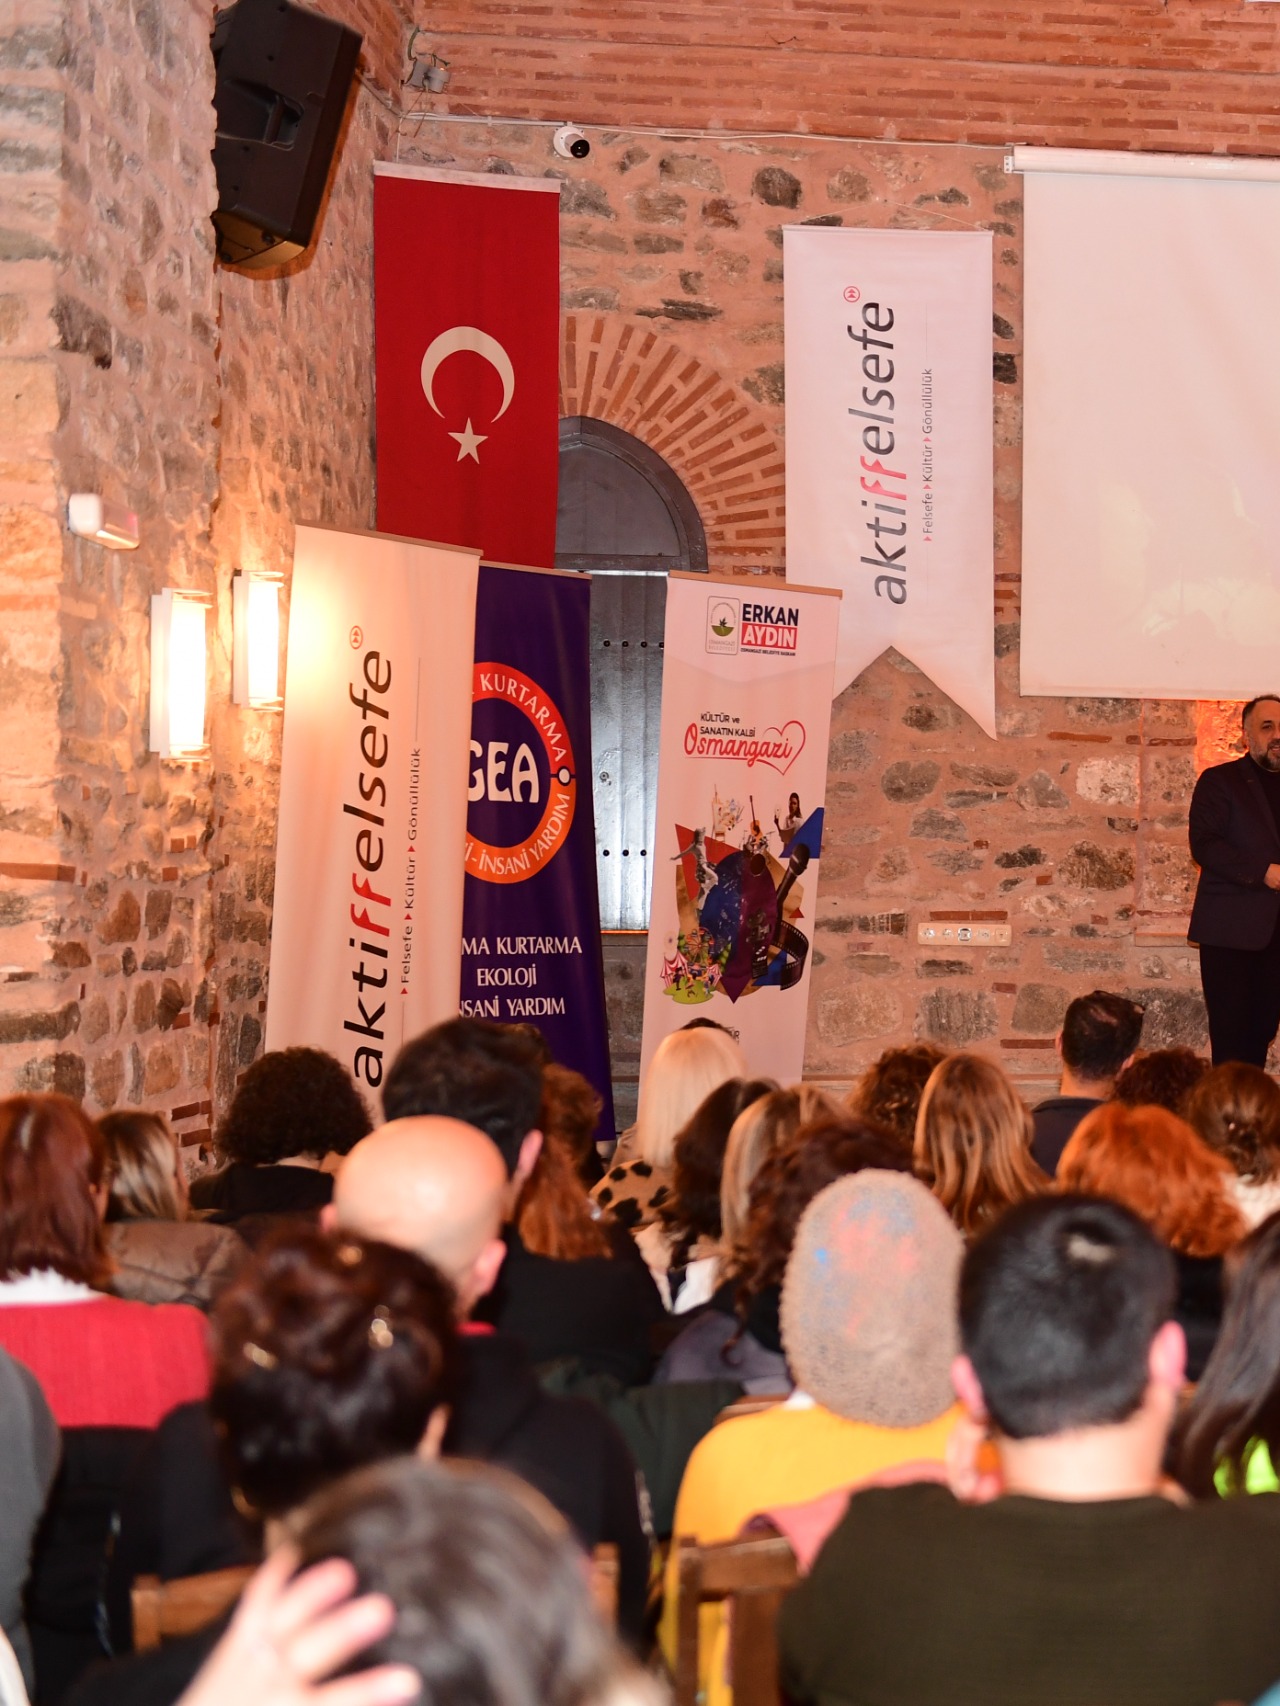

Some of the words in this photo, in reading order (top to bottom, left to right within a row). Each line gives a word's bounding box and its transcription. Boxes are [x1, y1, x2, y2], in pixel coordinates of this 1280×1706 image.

[922, 368, 932, 434] Gönüllülük
[847, 302, 907, 604] aktiffelsefe
[922, 445, 933, 482] Kültür
[922, 493, 933, 534] Felsefe
[742, 603, 799, 626] ERKAN
[743, 624, 795, 648] AYDIN
[480, 673, 567, 762] KURTARMA
[700, 712, 730, 724] KÜLTÜR
[700, 726, 734, 736] SANATIN
[735, 727, 756, 737] KALBİ
[684, 723, 792, 768] Osmangazi
[408, 748, 421, 841] Gönüllülük
[479, 848, 531, 875] İNSANİ
[529, 794, 570, 861] YARDIM
[343, 651, 392, 1088] aktiffelsefe
[404, 857, 416, 909] Kültür
[401, 926, 413, 983] Felsefe
[496, 936, 582, 954] KURTARMA
[477, 963, 537, 988] EKOLOJİ
[507, 997, 565, 1016] YARDIM
